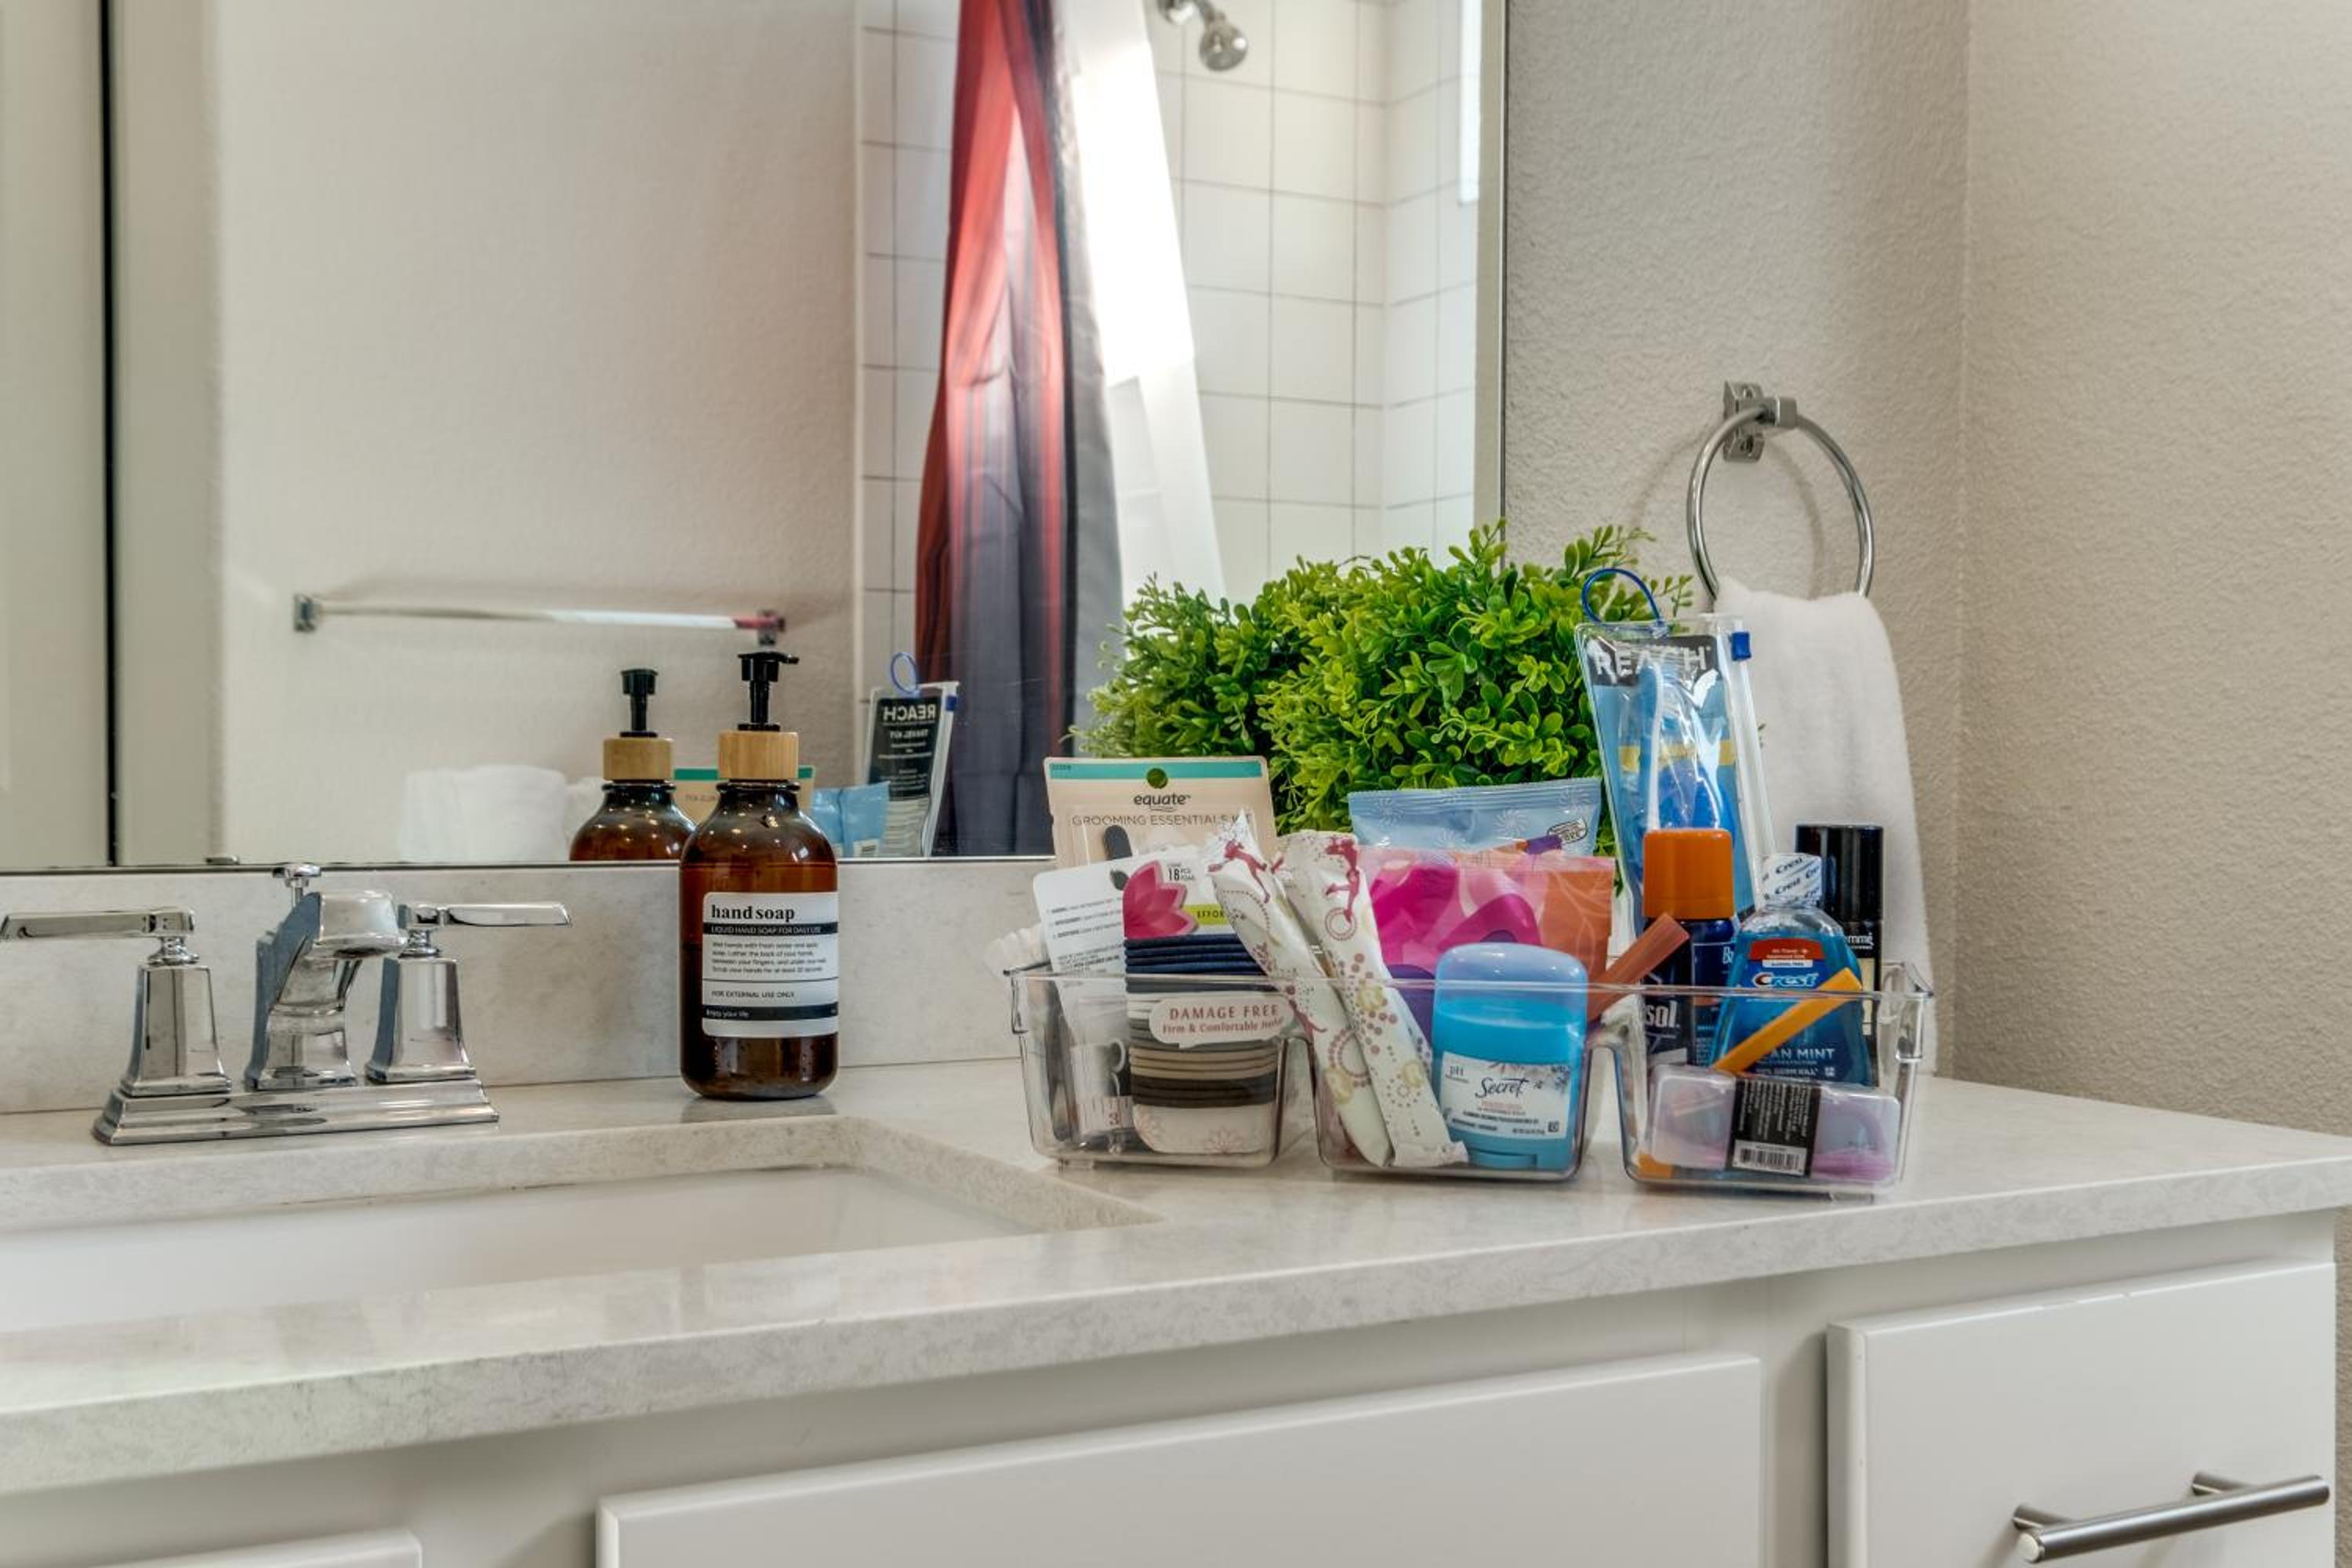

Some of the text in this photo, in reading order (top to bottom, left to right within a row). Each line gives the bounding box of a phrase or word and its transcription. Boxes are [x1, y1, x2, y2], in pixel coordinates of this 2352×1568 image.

[1133, 793, 1187, 808] equate
[1072, 814, 1252, 826] GROOMING ESSENTIALS KT
[1775, 857, 1802, 874] Crest
[1775, 877, 1801, 895] Crest
[711, 905, 795, 923] hand soap
[757, 926, 776, 935] SOAP
[1751, 972, 1820, 988] Crest
[1169, 1004, 1279, 1020] DAMAGE FREE
[1163, 1025, 1185, 1034] Firm
[1189, 1024, 1196, 1033] &
[1200, 1021, 1258, 1033] Comfortable
[1797, 1047, 1835, 1059] MINT
[1450, 1065, 1465, 1077] pH
[1475, 1076, 1530, 1098] Secret
